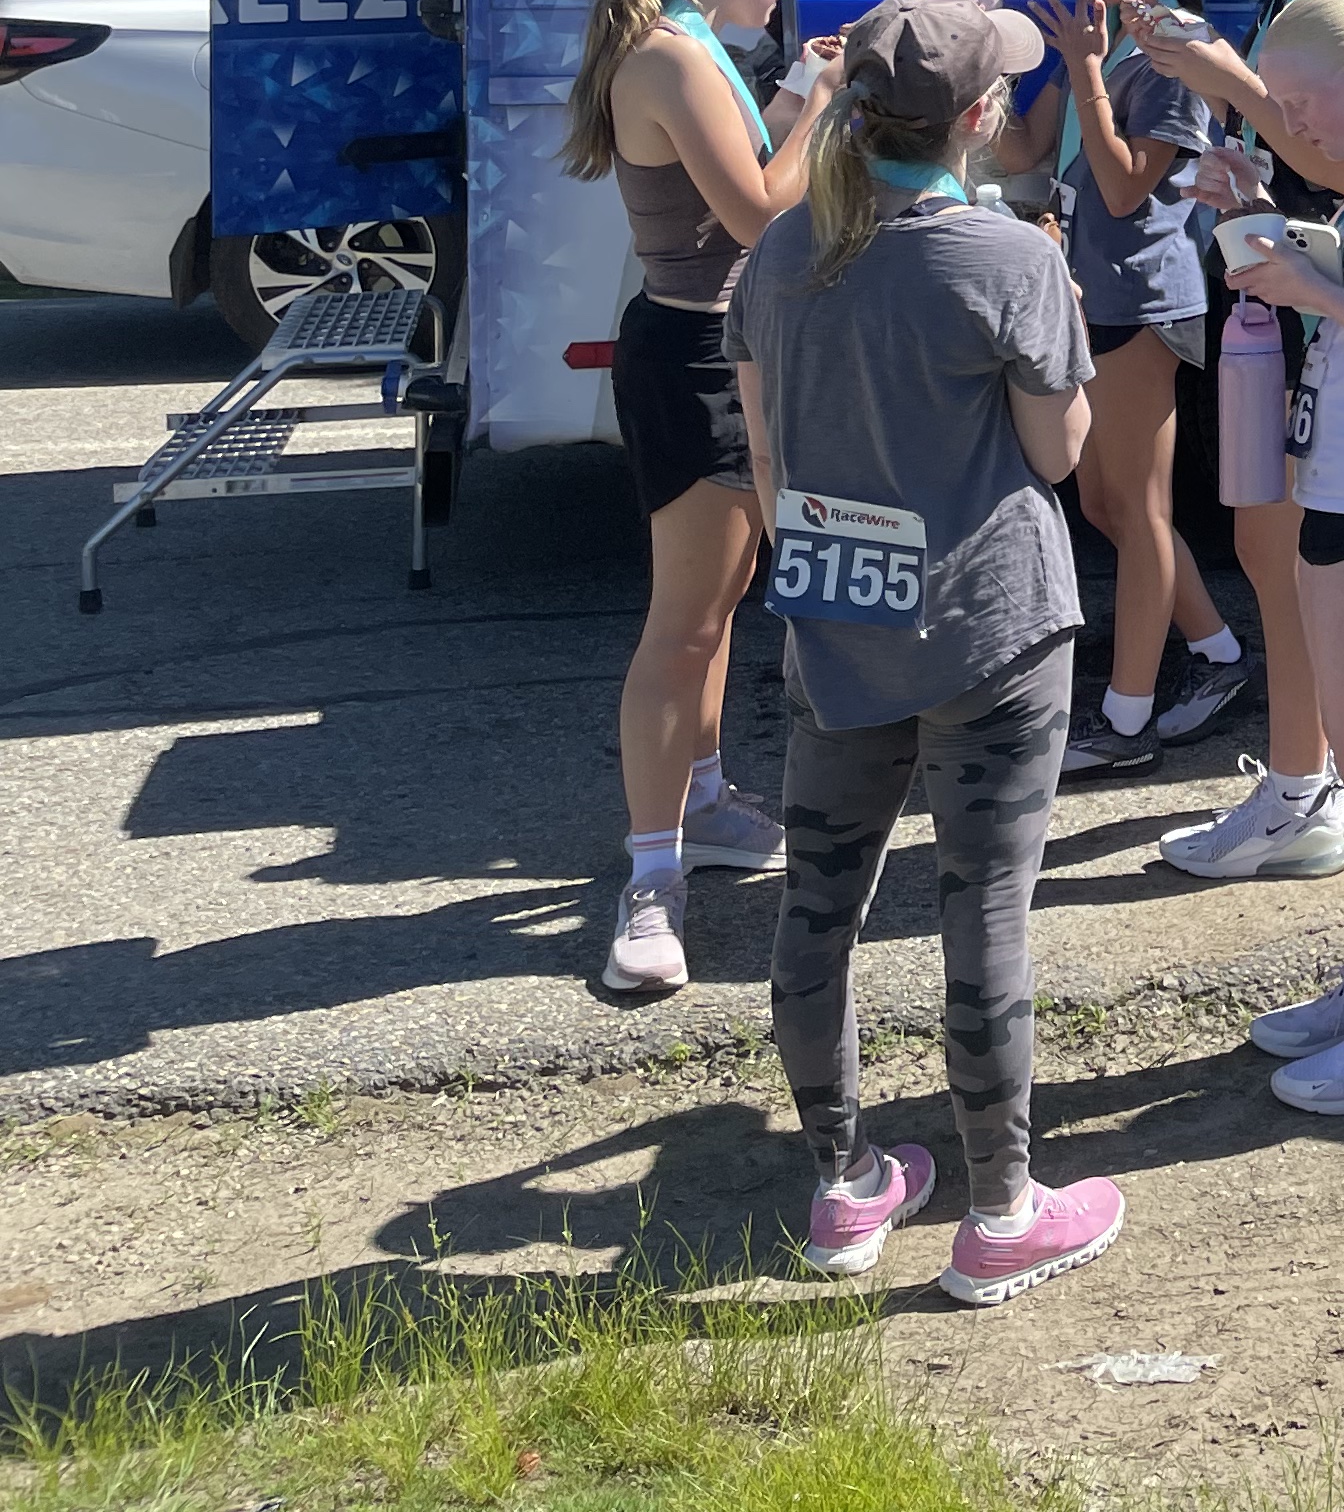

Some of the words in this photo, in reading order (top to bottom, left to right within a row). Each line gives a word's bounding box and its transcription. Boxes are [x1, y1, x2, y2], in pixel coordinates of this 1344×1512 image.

[1287, 390, 1314, 447] 6
[830, 507, 901, 530] RaceWire
[774, 537, 920, 612] 5155
